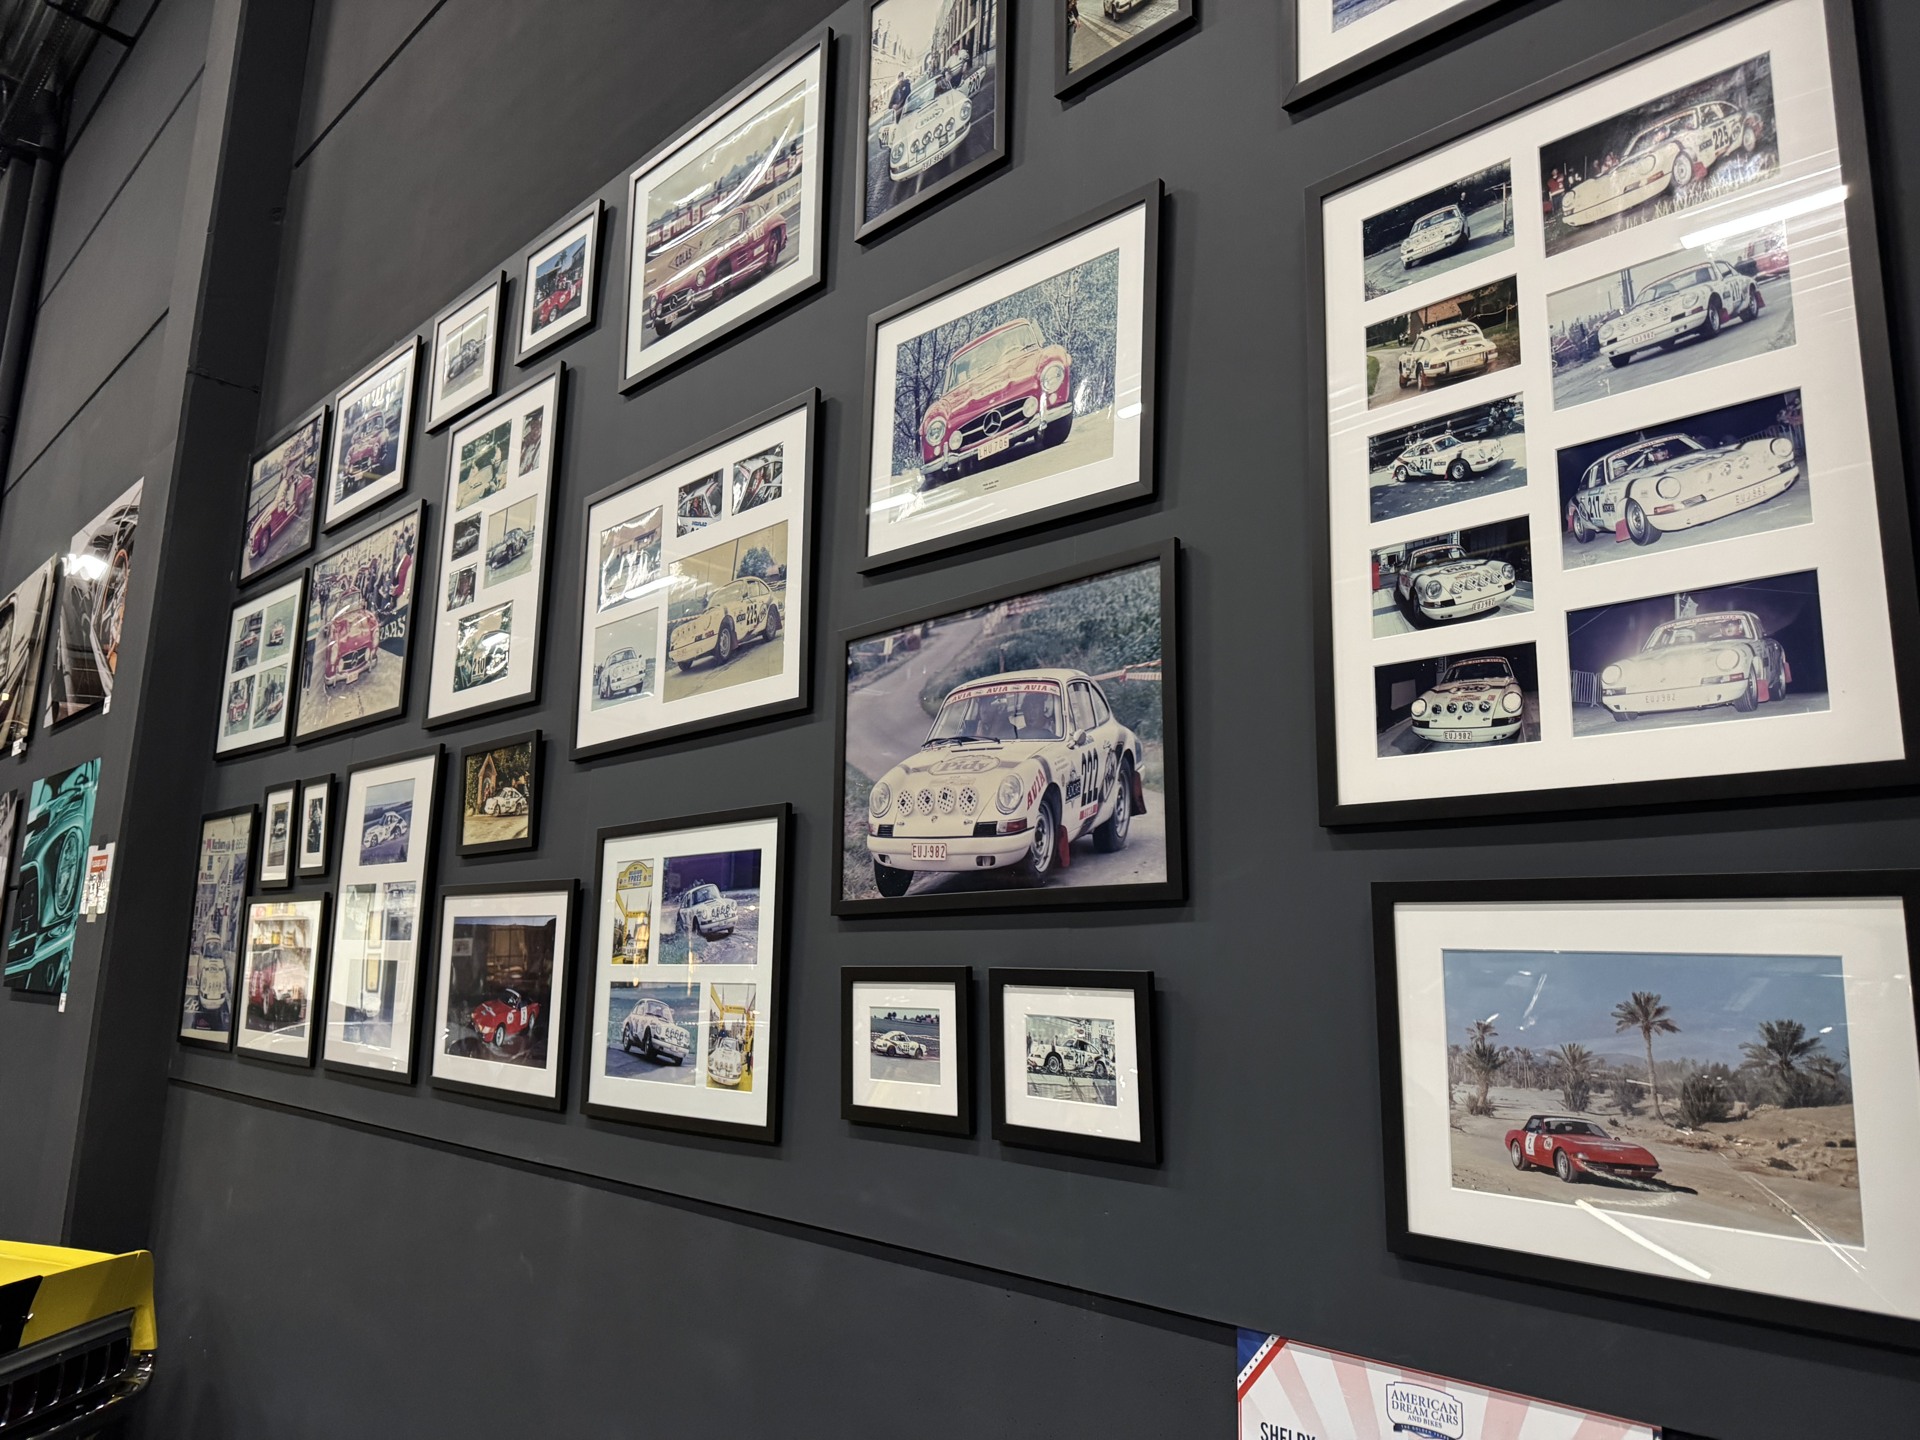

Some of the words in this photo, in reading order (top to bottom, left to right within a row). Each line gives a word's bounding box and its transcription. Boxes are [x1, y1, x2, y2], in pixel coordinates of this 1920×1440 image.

[1712, 125, 1730, 150] 225
[674, 248, 692, 268] COLAS
[1420, 459, 1433, 470] 217
[1587, 495, 1601, 519] 217
[747, 604, 758, 626] 225
[952, 692, 972, 701] AVIA
[986, 686, 1008, 694] AVIA
[939, 760, 991, 772] Pidy
[1081, 748, 1099, 807] 222
[1027, 769, 1046, 812] AVIA
[1075, 1053, 1086, 1065] 217
[1391, 1389, 1458, 1416] AMERICAN
[1391, 1400, 1428, 1418] DREAM
[1431, 1410, 1459, 1426] CARS
[1408, 1414, 1422, 1424] AND
[1423, 1418, 1443, 1429] BIKES
[1412, 1426, 1432, 1435] GOLDEN
